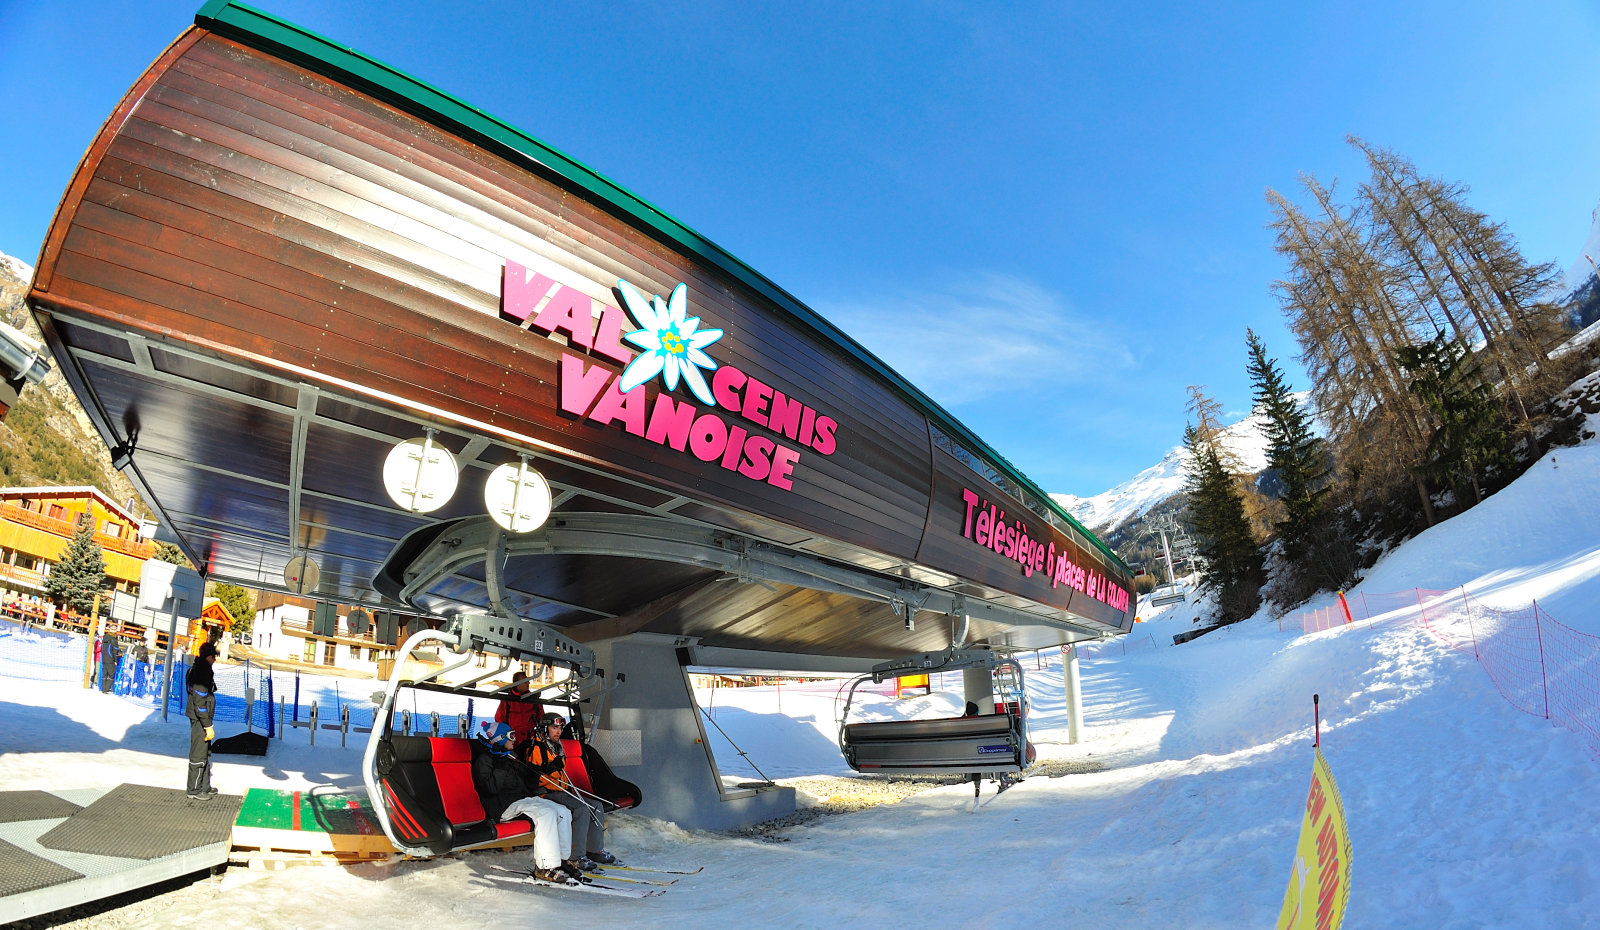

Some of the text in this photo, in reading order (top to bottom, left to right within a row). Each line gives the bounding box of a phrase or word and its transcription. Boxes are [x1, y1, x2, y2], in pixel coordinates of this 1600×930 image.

[502, 258, 838, 456] VAL CENIS
[561, 352, 801, 492] VANOISE
[962, 487, 1045, 578] Télésiège
[1046, 541, 1055, 577] 6
[1053, 550, 1086, 589] places
[1086, 568, 1097, 598] de
[1096, 573, 1107, 603] LA
